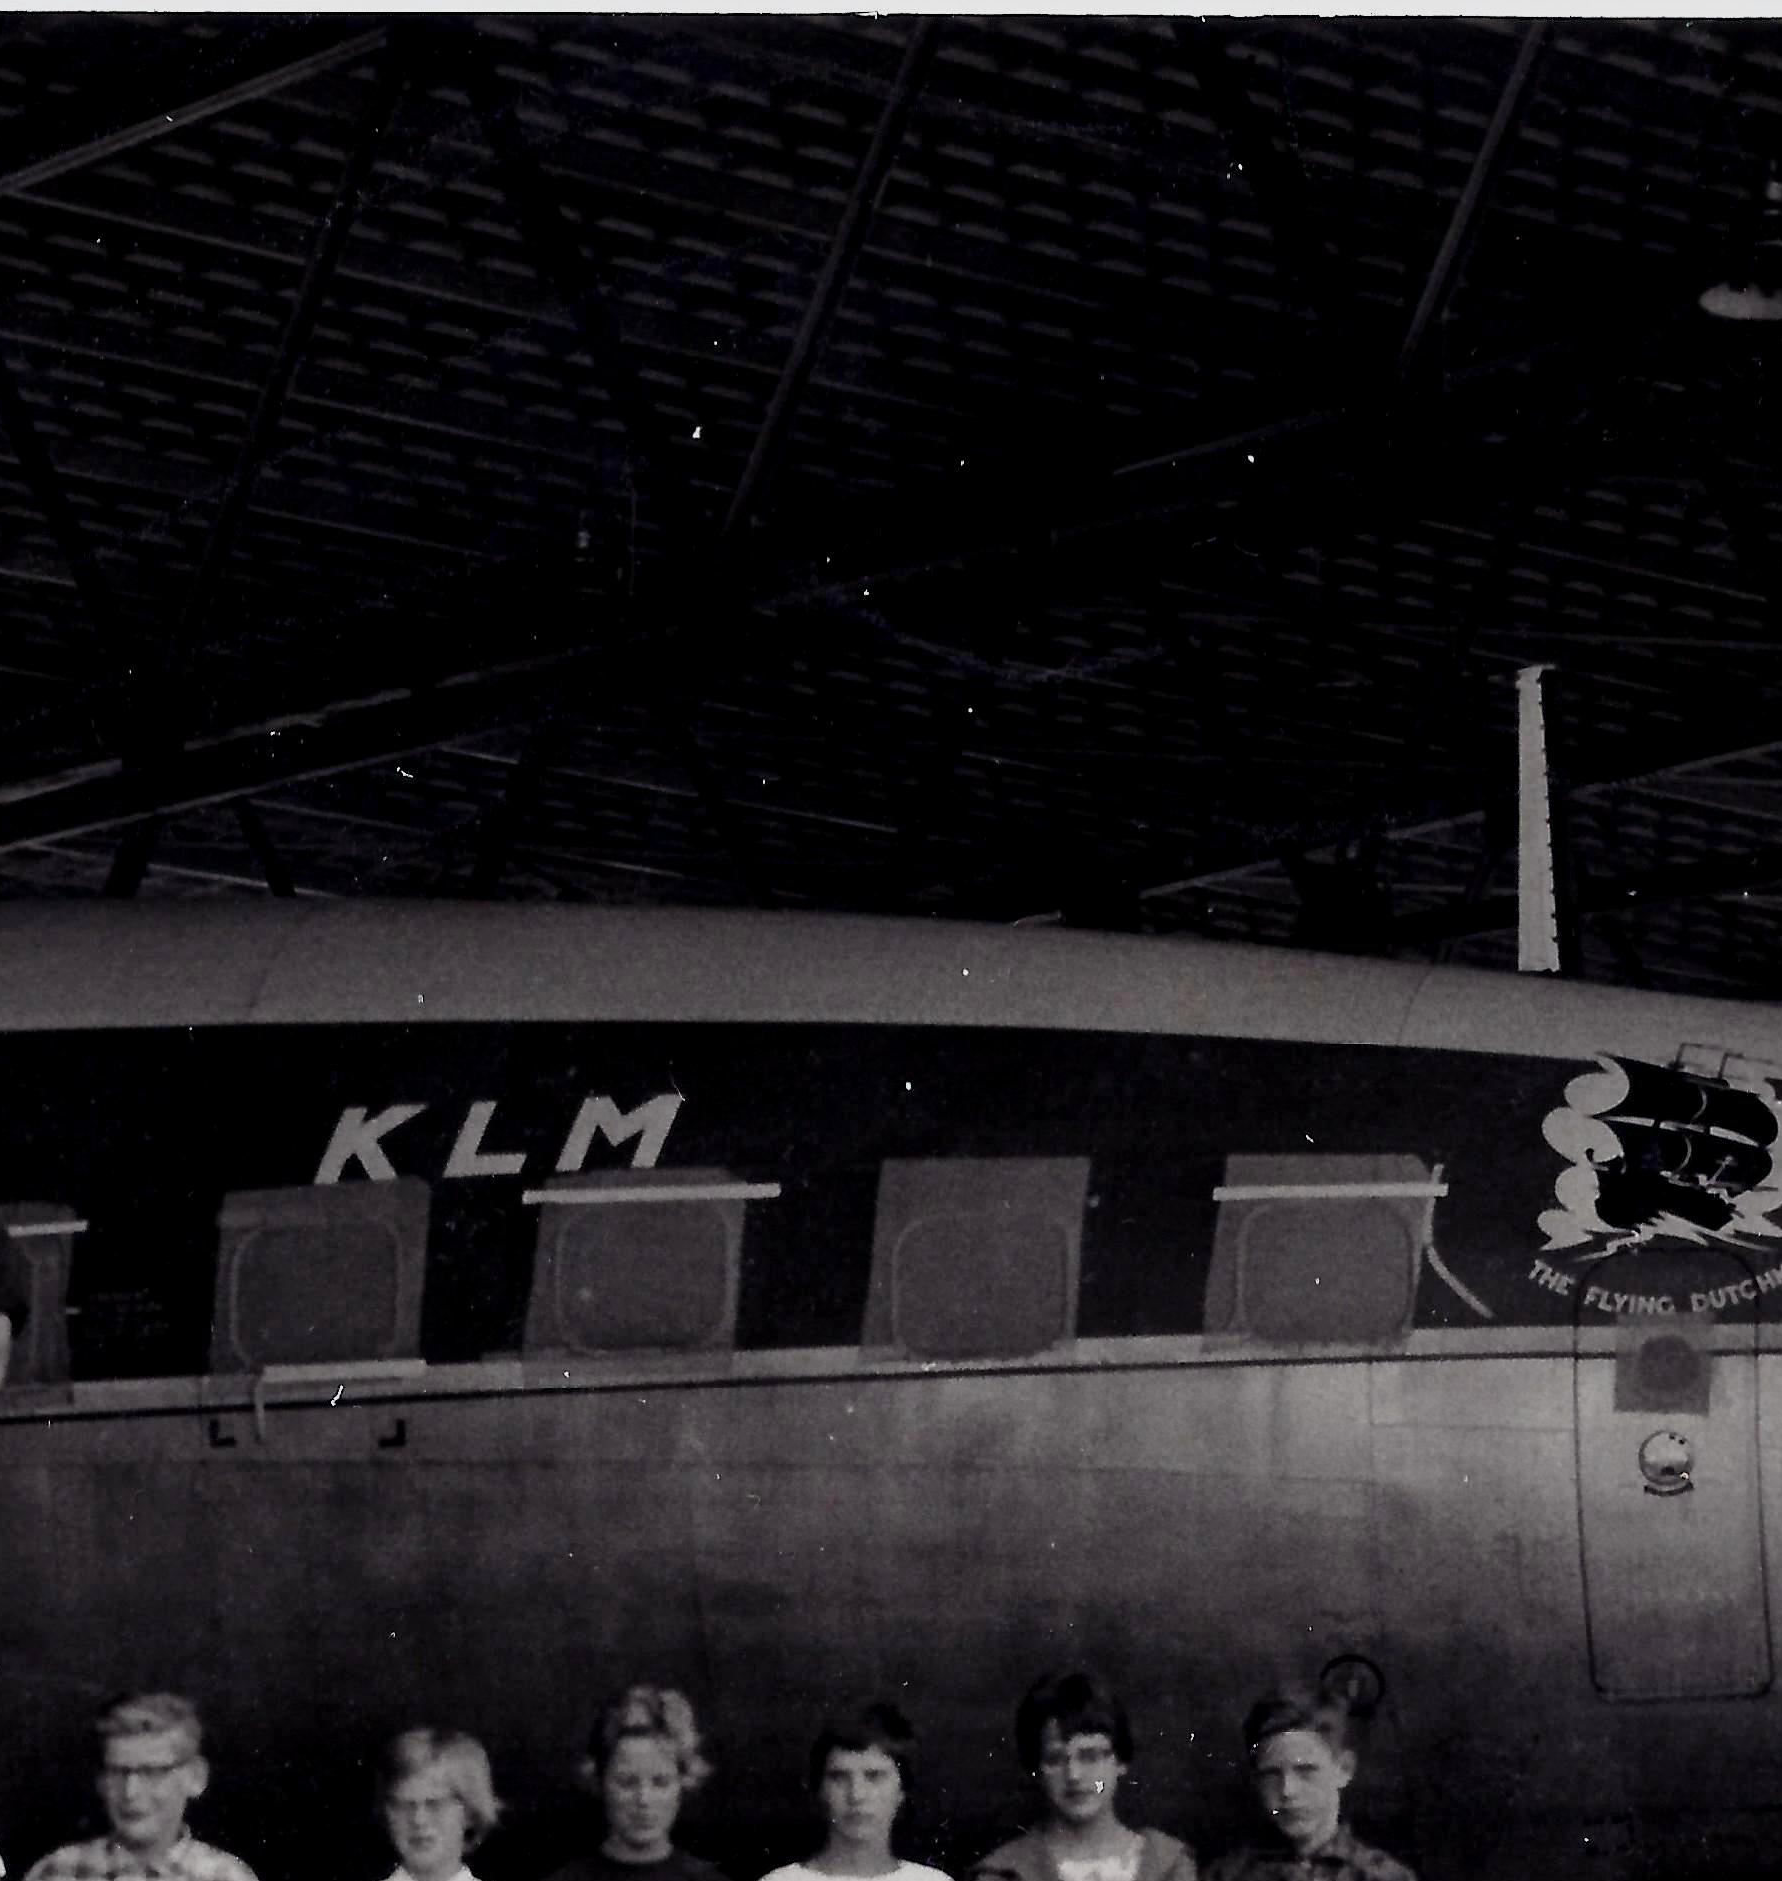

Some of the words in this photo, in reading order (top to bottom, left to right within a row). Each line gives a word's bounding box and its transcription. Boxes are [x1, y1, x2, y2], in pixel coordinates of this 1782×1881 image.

[314, 1094, 682, 1186] KLM
[1528, 1259, 1575, 1296] THE
[1583, 1286, 1675, 1314] FLYING
